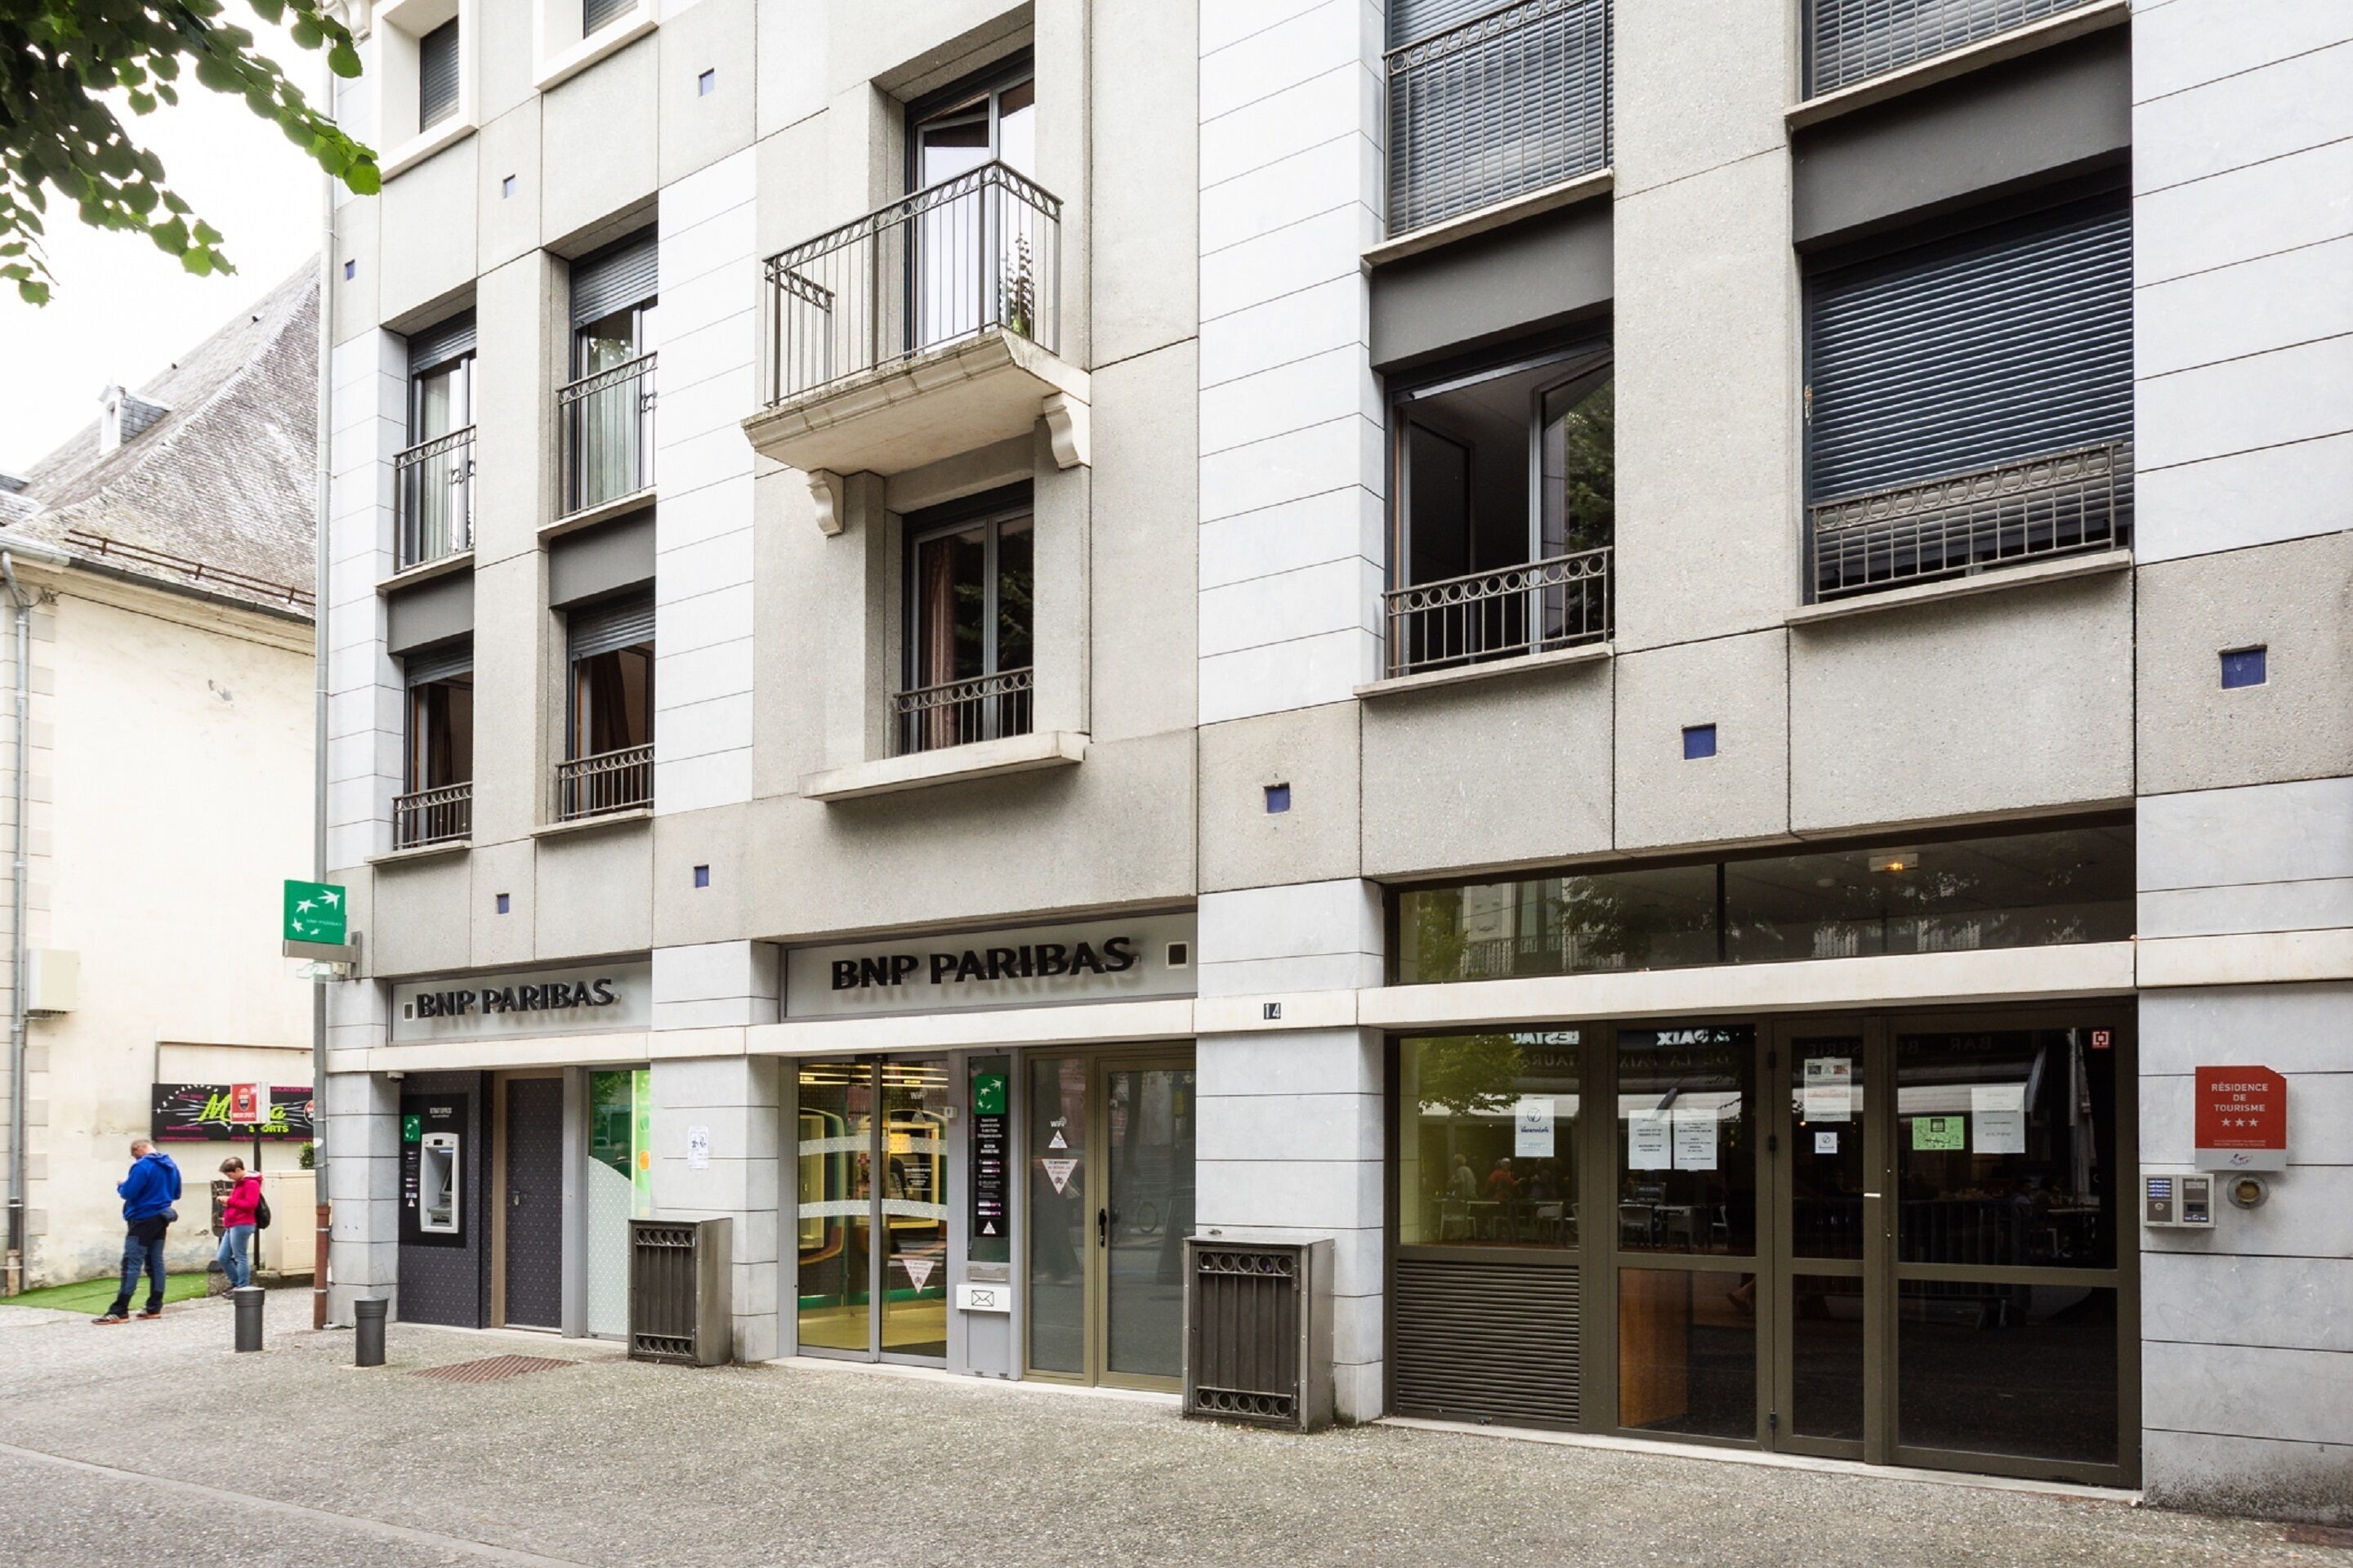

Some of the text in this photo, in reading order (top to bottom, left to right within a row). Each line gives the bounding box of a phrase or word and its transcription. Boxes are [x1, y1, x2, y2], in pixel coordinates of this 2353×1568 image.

[832, 936, 1136, 990] BNP PARIBAS
[417, 978, 614, 1018] BNP PARIBAS
[1265, 1003, 1280, 1019] 14
[2211, 1081, 2269, 1092] RÉSIDENCE
[2233, 1093, 2247, 1101] DE
[2214, 1104, 2266, 1112] TOURISME
[248, 1124, 289, 1133] SORTS
